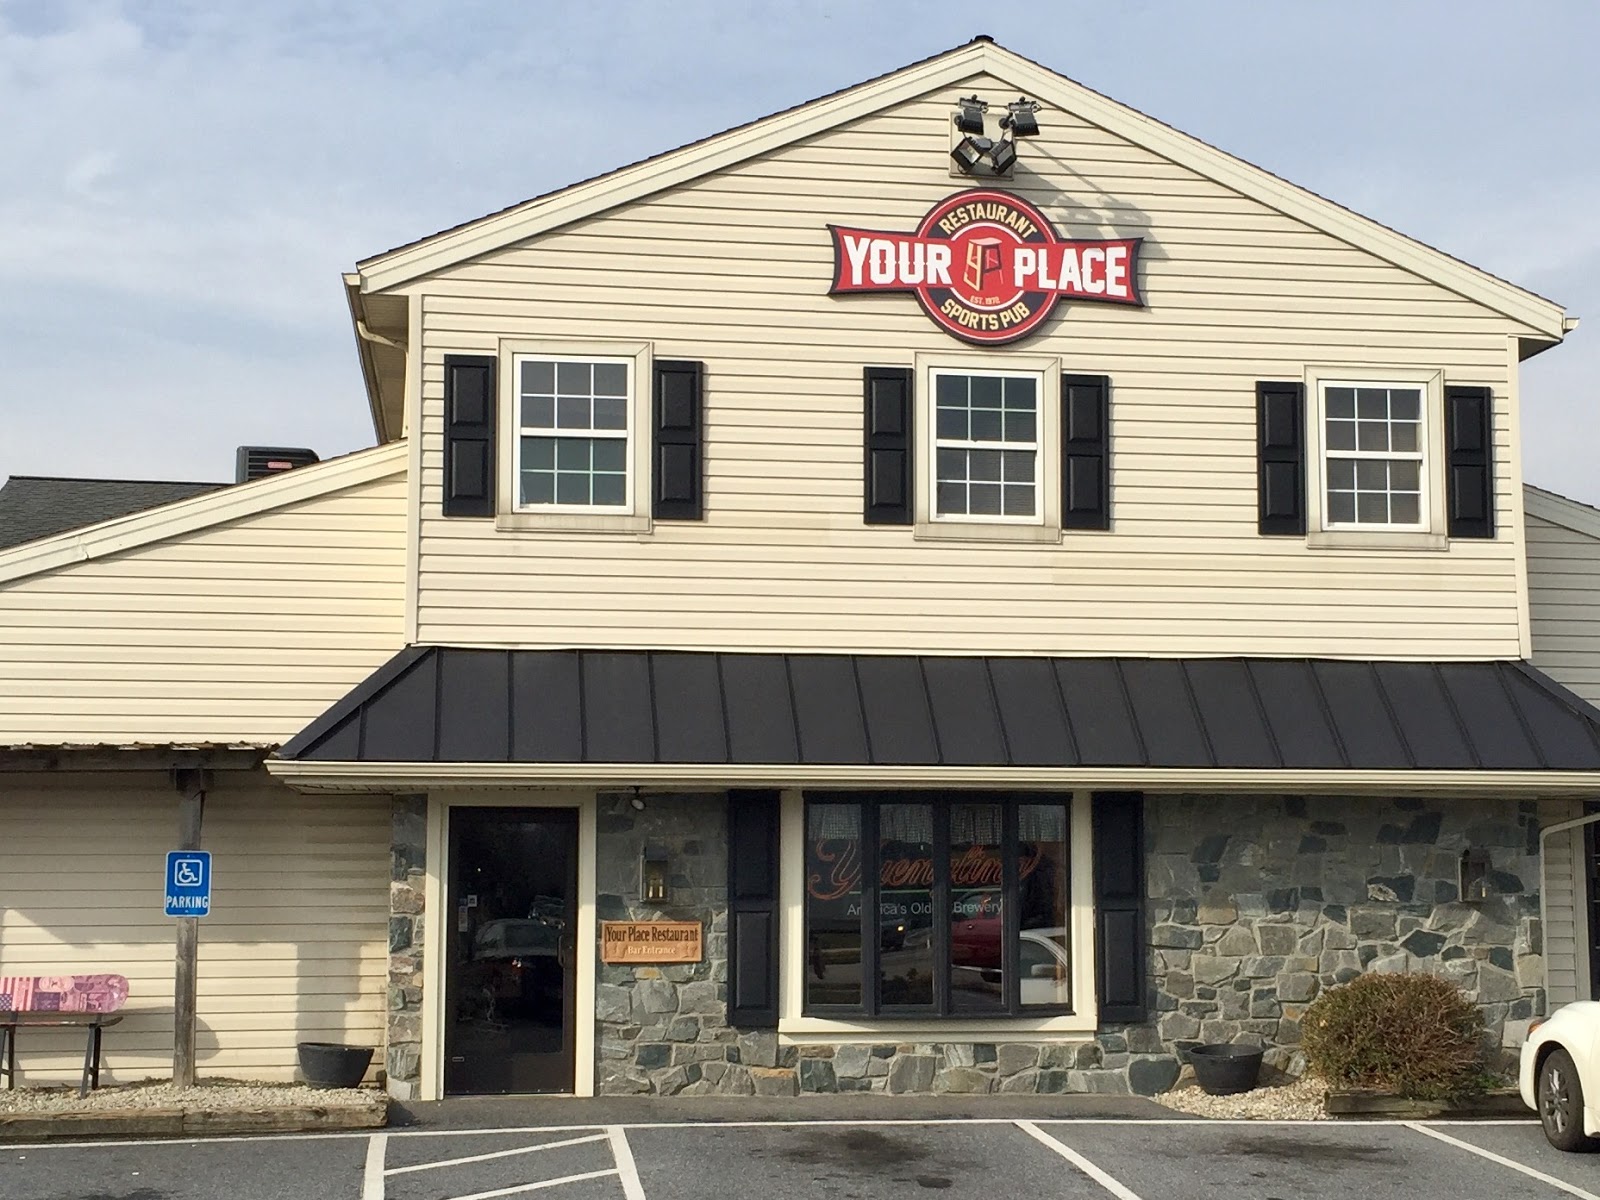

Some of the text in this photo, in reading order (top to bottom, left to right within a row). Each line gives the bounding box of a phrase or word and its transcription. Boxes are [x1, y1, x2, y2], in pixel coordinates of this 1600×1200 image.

[937, 203, 1038, 238] RESTAURANT
[843, 235, 1128, 297] YOUR PLACE
[940, 299, 1031, 330] SPORTS PUB
[166, 896, 209, 908] PARKING
[606, 926, 698, 942] Your Place Restaurant
[627, 945, 676, 954] Bar Entrance
